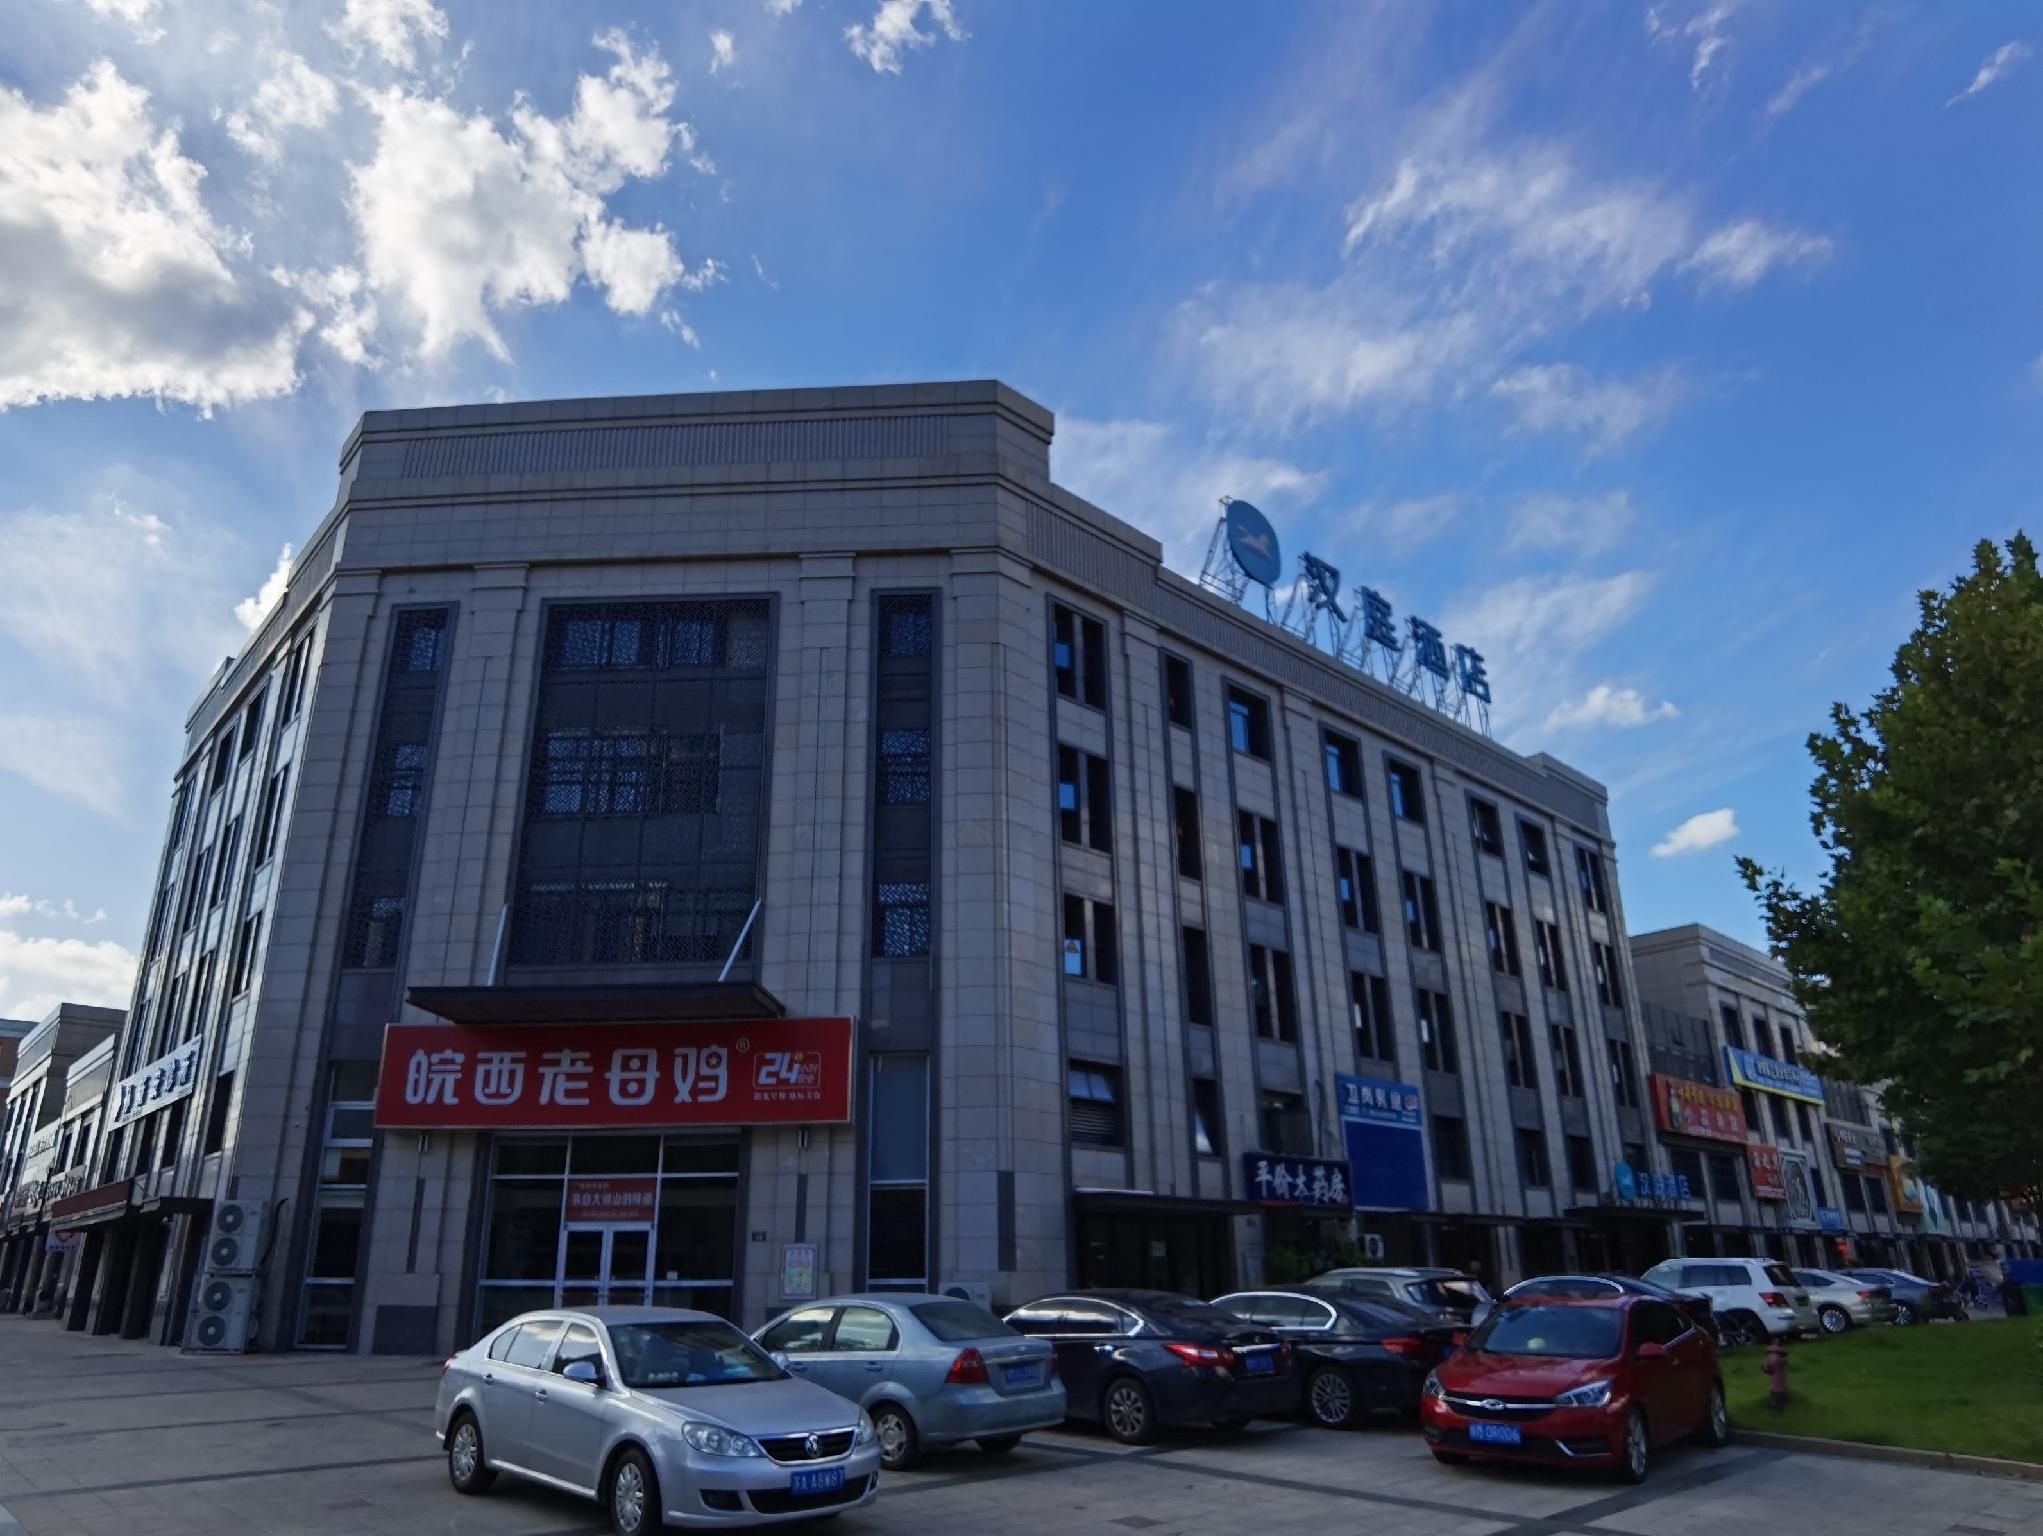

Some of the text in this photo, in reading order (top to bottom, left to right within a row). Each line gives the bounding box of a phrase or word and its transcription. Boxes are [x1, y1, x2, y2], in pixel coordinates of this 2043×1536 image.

[405, 1044, 729, 1106] 皖西老母鸡
[757, 1052, 801, 1085] 24
